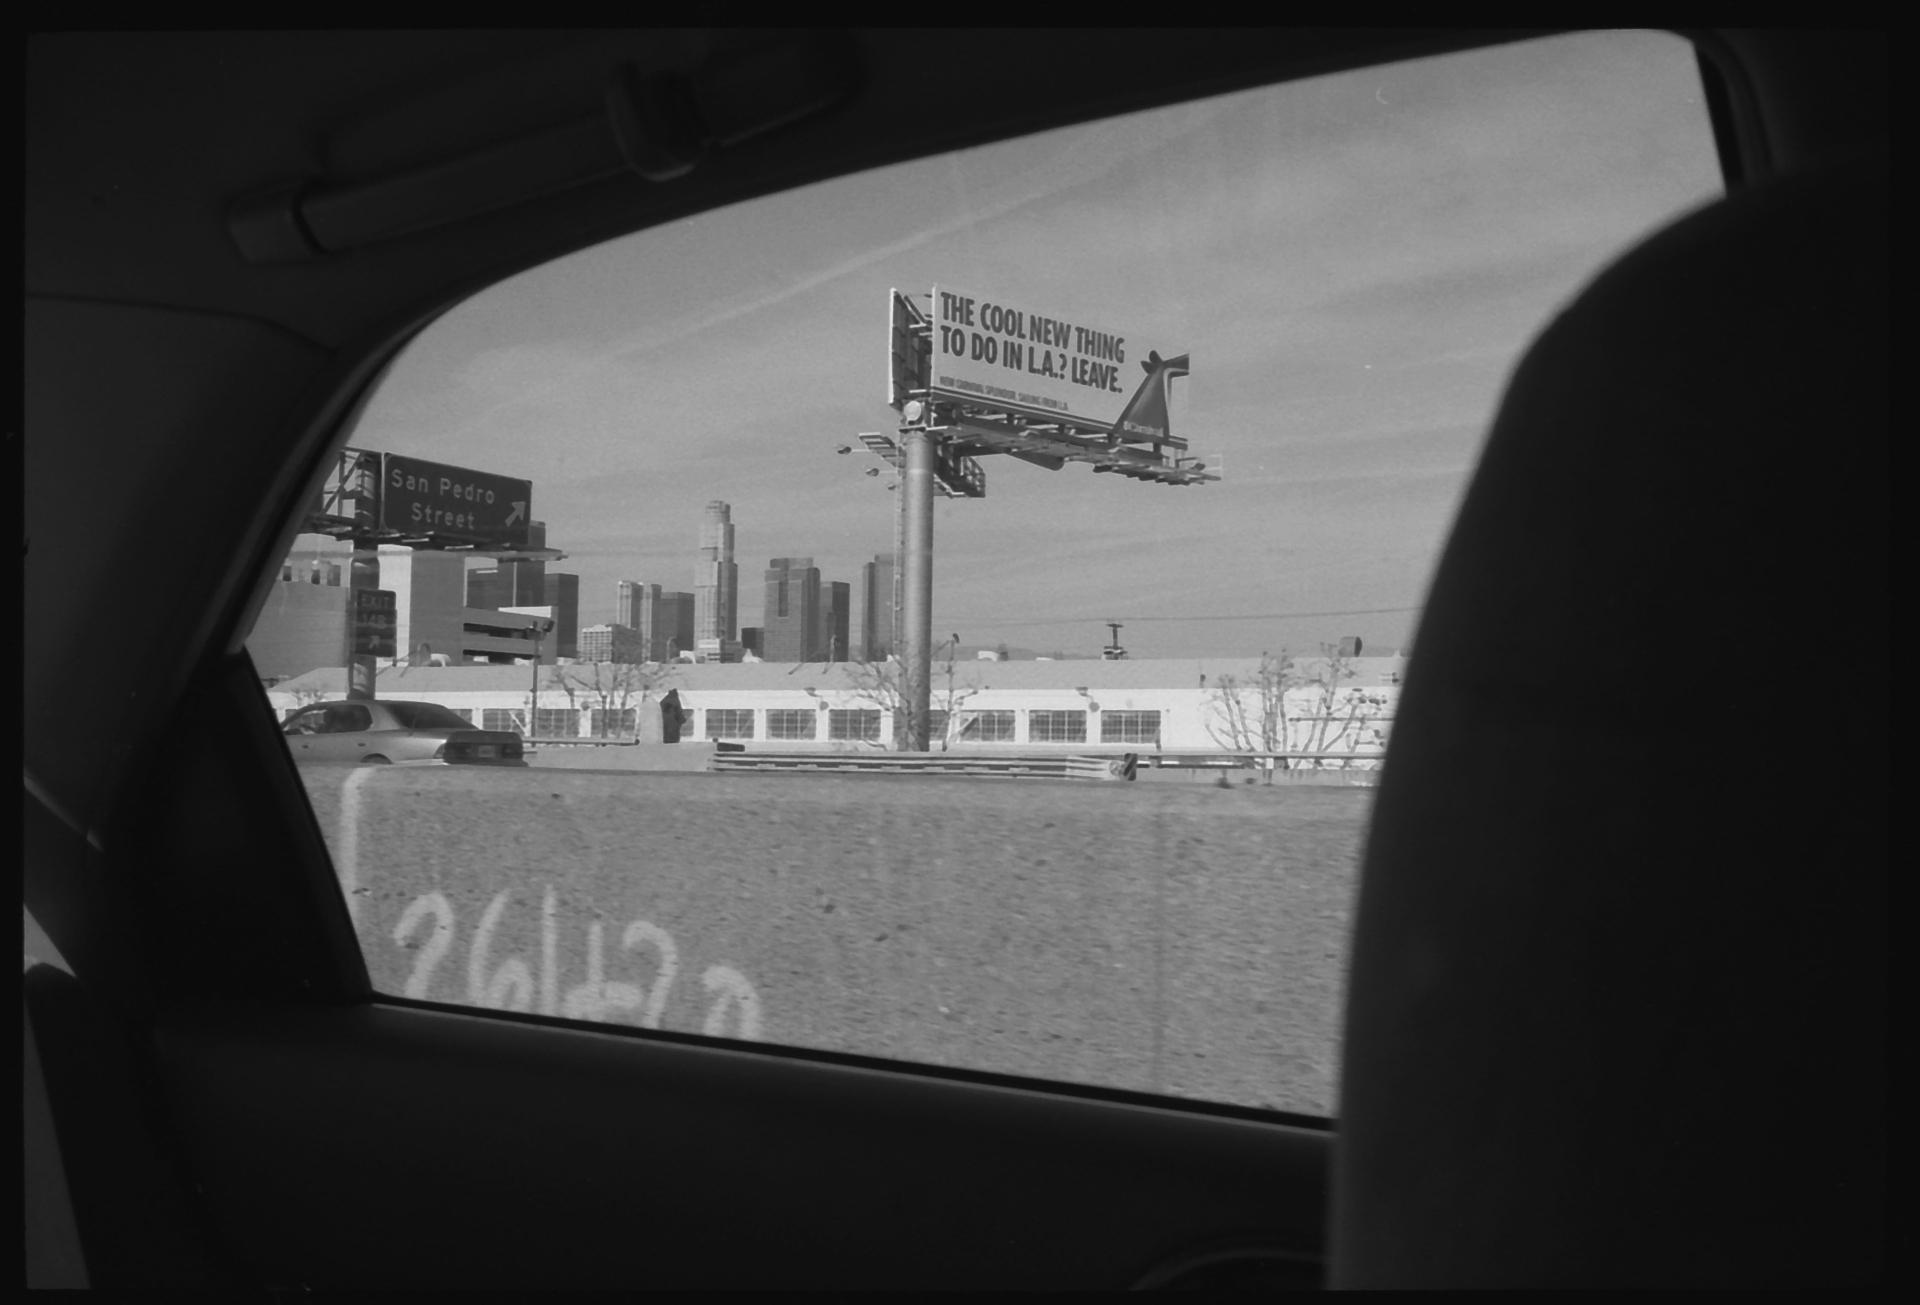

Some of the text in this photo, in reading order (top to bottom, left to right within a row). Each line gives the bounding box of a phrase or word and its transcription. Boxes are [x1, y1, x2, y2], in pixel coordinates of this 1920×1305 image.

[940, 291, 1125, 364] THE COOL NEW THING
[940, 325, 1123, 393] TO DO IN L.A.? LEAVE.
[391, 469, 495, 504] San Pedro
[411, 502, 475, 530] Street
[361, 594, 390, 610] EXIT
